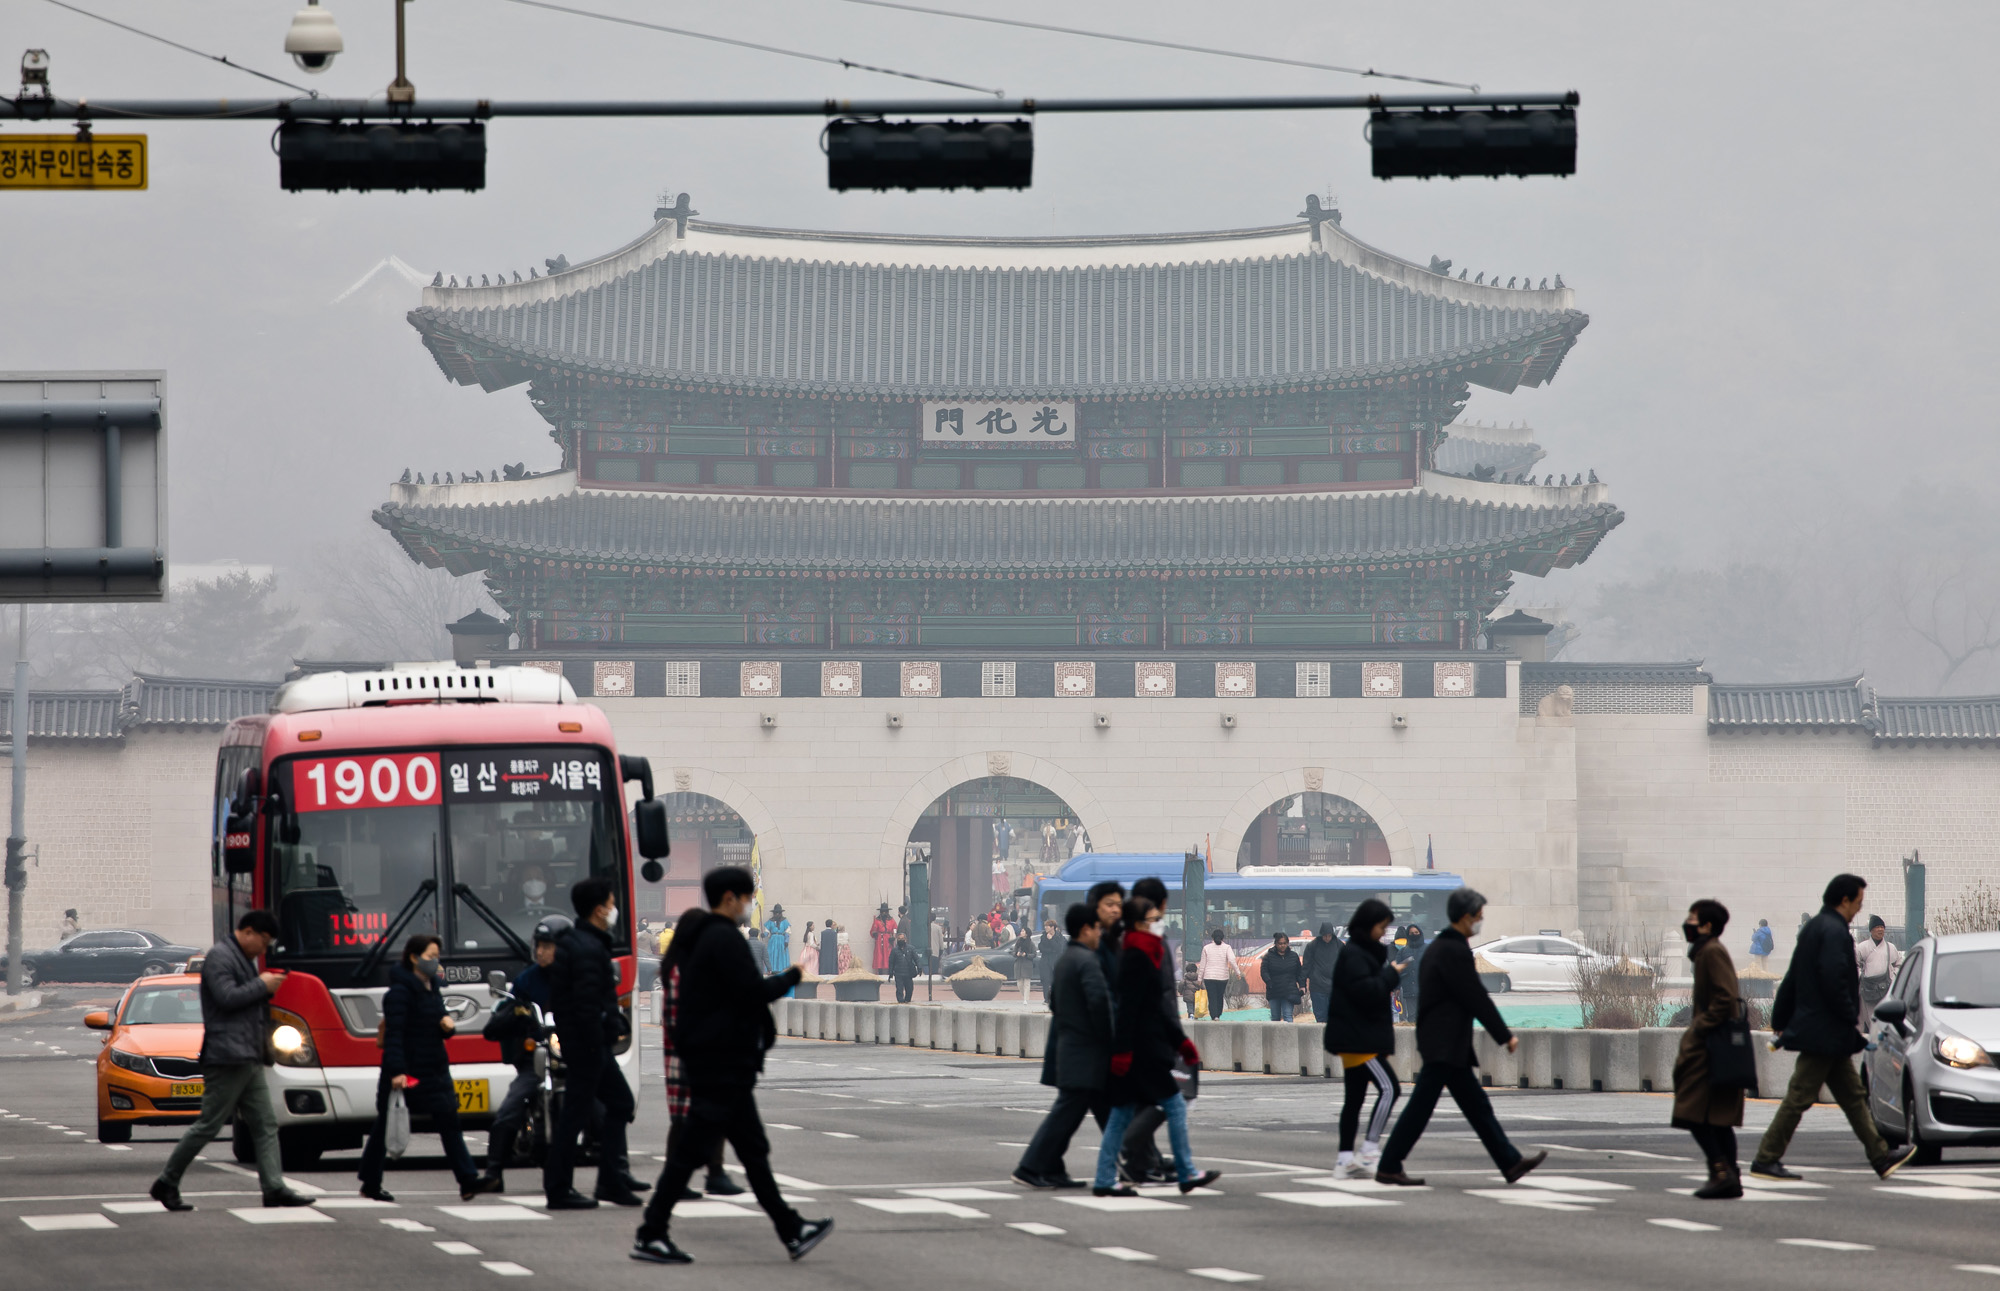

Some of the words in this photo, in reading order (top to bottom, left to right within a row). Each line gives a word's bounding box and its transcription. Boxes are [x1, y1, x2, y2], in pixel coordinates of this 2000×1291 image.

[1, 148, 134, 179] 정차무인단속중
[308, 756, 437, 806] 1900
[550, 760, 602, 791] 서울역
[446, 965, 482, 982] BUS
